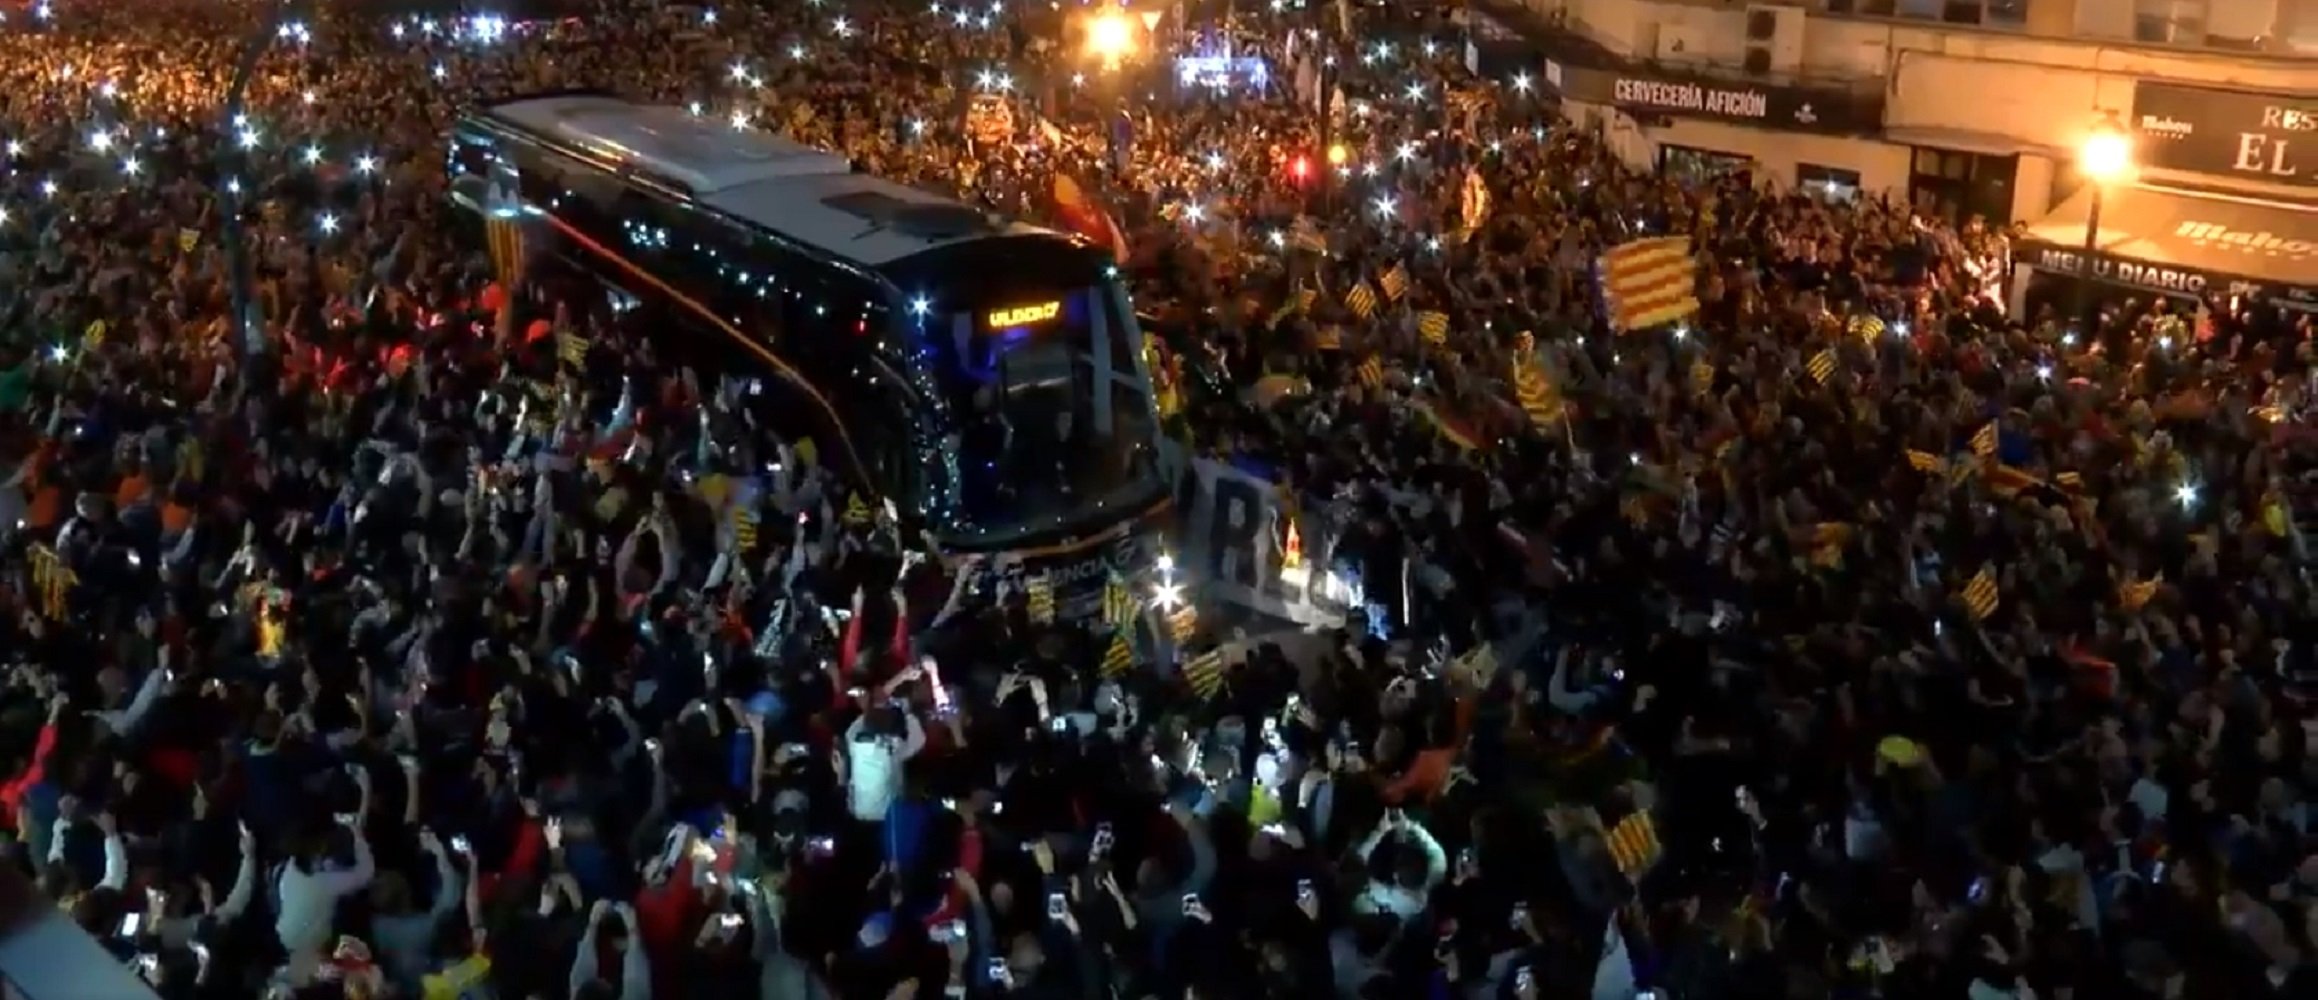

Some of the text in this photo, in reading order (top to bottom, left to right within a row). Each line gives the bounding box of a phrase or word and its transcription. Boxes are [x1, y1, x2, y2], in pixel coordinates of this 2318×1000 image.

[1615, 79, 1702, 110] CERVECERÍA
[1706, 90, 1766, 117] AFICIÓN
[2233, 132, 2296, 176] EL
[2041, 249, 2110, 276] MEU
[2118, 262, 2206, 292] DIARIO
